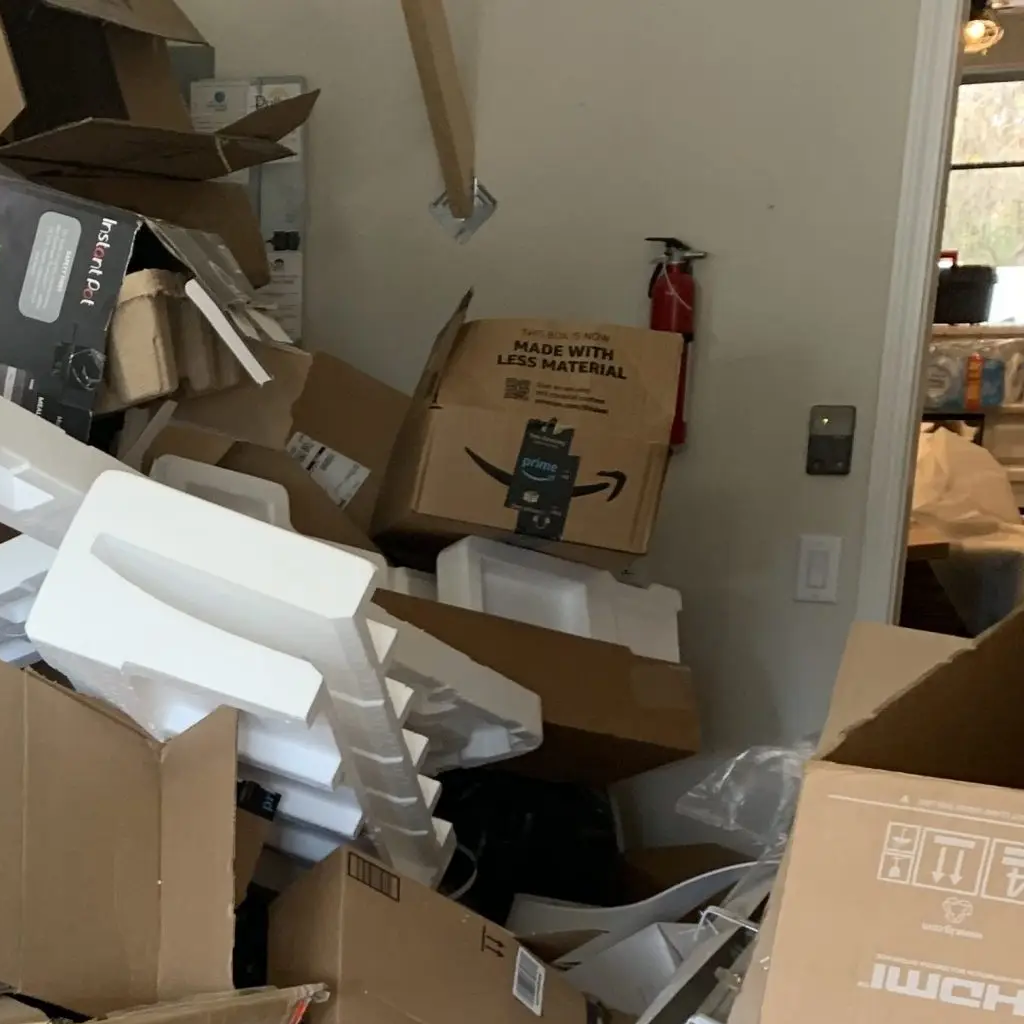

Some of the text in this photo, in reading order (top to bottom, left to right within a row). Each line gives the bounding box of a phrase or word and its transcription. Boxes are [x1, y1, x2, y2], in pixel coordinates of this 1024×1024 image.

[77, 216, 117, 307] Instant Pot
[513, 340, 614, 360] MADE WITH
[495, 354, 627, 379] LESS MATERIAL
[520, 458, 558, 472] prime
[868, 963, 1024, 1016] HDMI
